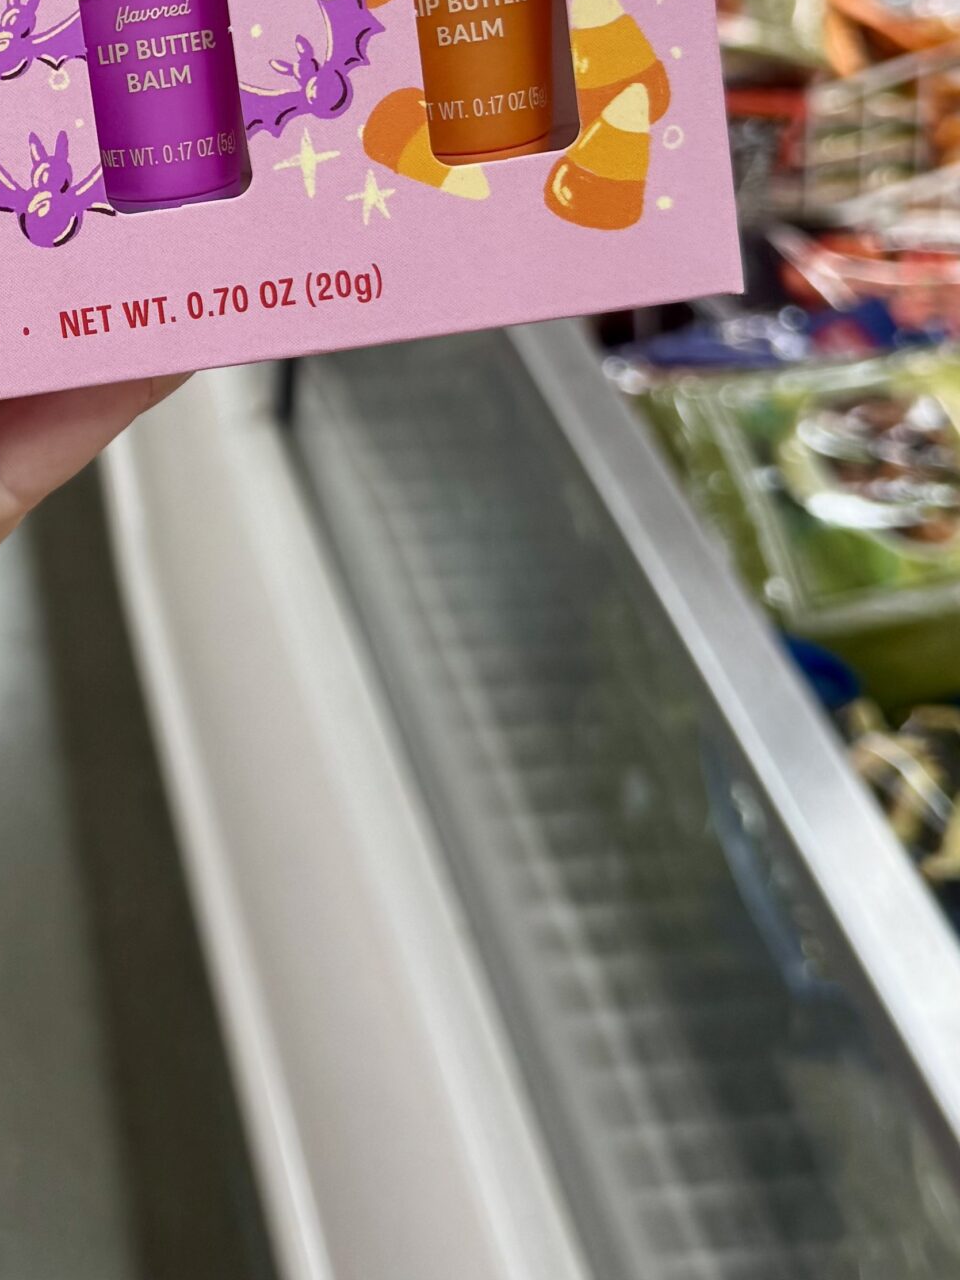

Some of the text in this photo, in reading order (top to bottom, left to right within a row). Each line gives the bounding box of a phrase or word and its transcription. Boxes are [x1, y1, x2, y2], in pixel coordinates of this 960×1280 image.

[97, 29, 217, 66] LIP BUTTER
[436, 17, 504, 47] BALM
[126, 64, 193, 94] BALM
[438, 100, 469, 120] WT.
[472, 94, 504, 117] 0.17
[508, 90, 527, 111] OZ
[101, 150, 125, 168] NET
[129, 146, 159, 167] WT.
[162, 141, 193, 164] 0.17
[196, 136, 215, 157] OZ
[58, 304, 113, 340] NET
[121, 296, 178, 330] WT.
[186, 284, 250, 321] 0.70
[257, 277, 296, 310] OZ
[303, 262, 385, 309] (20g)
